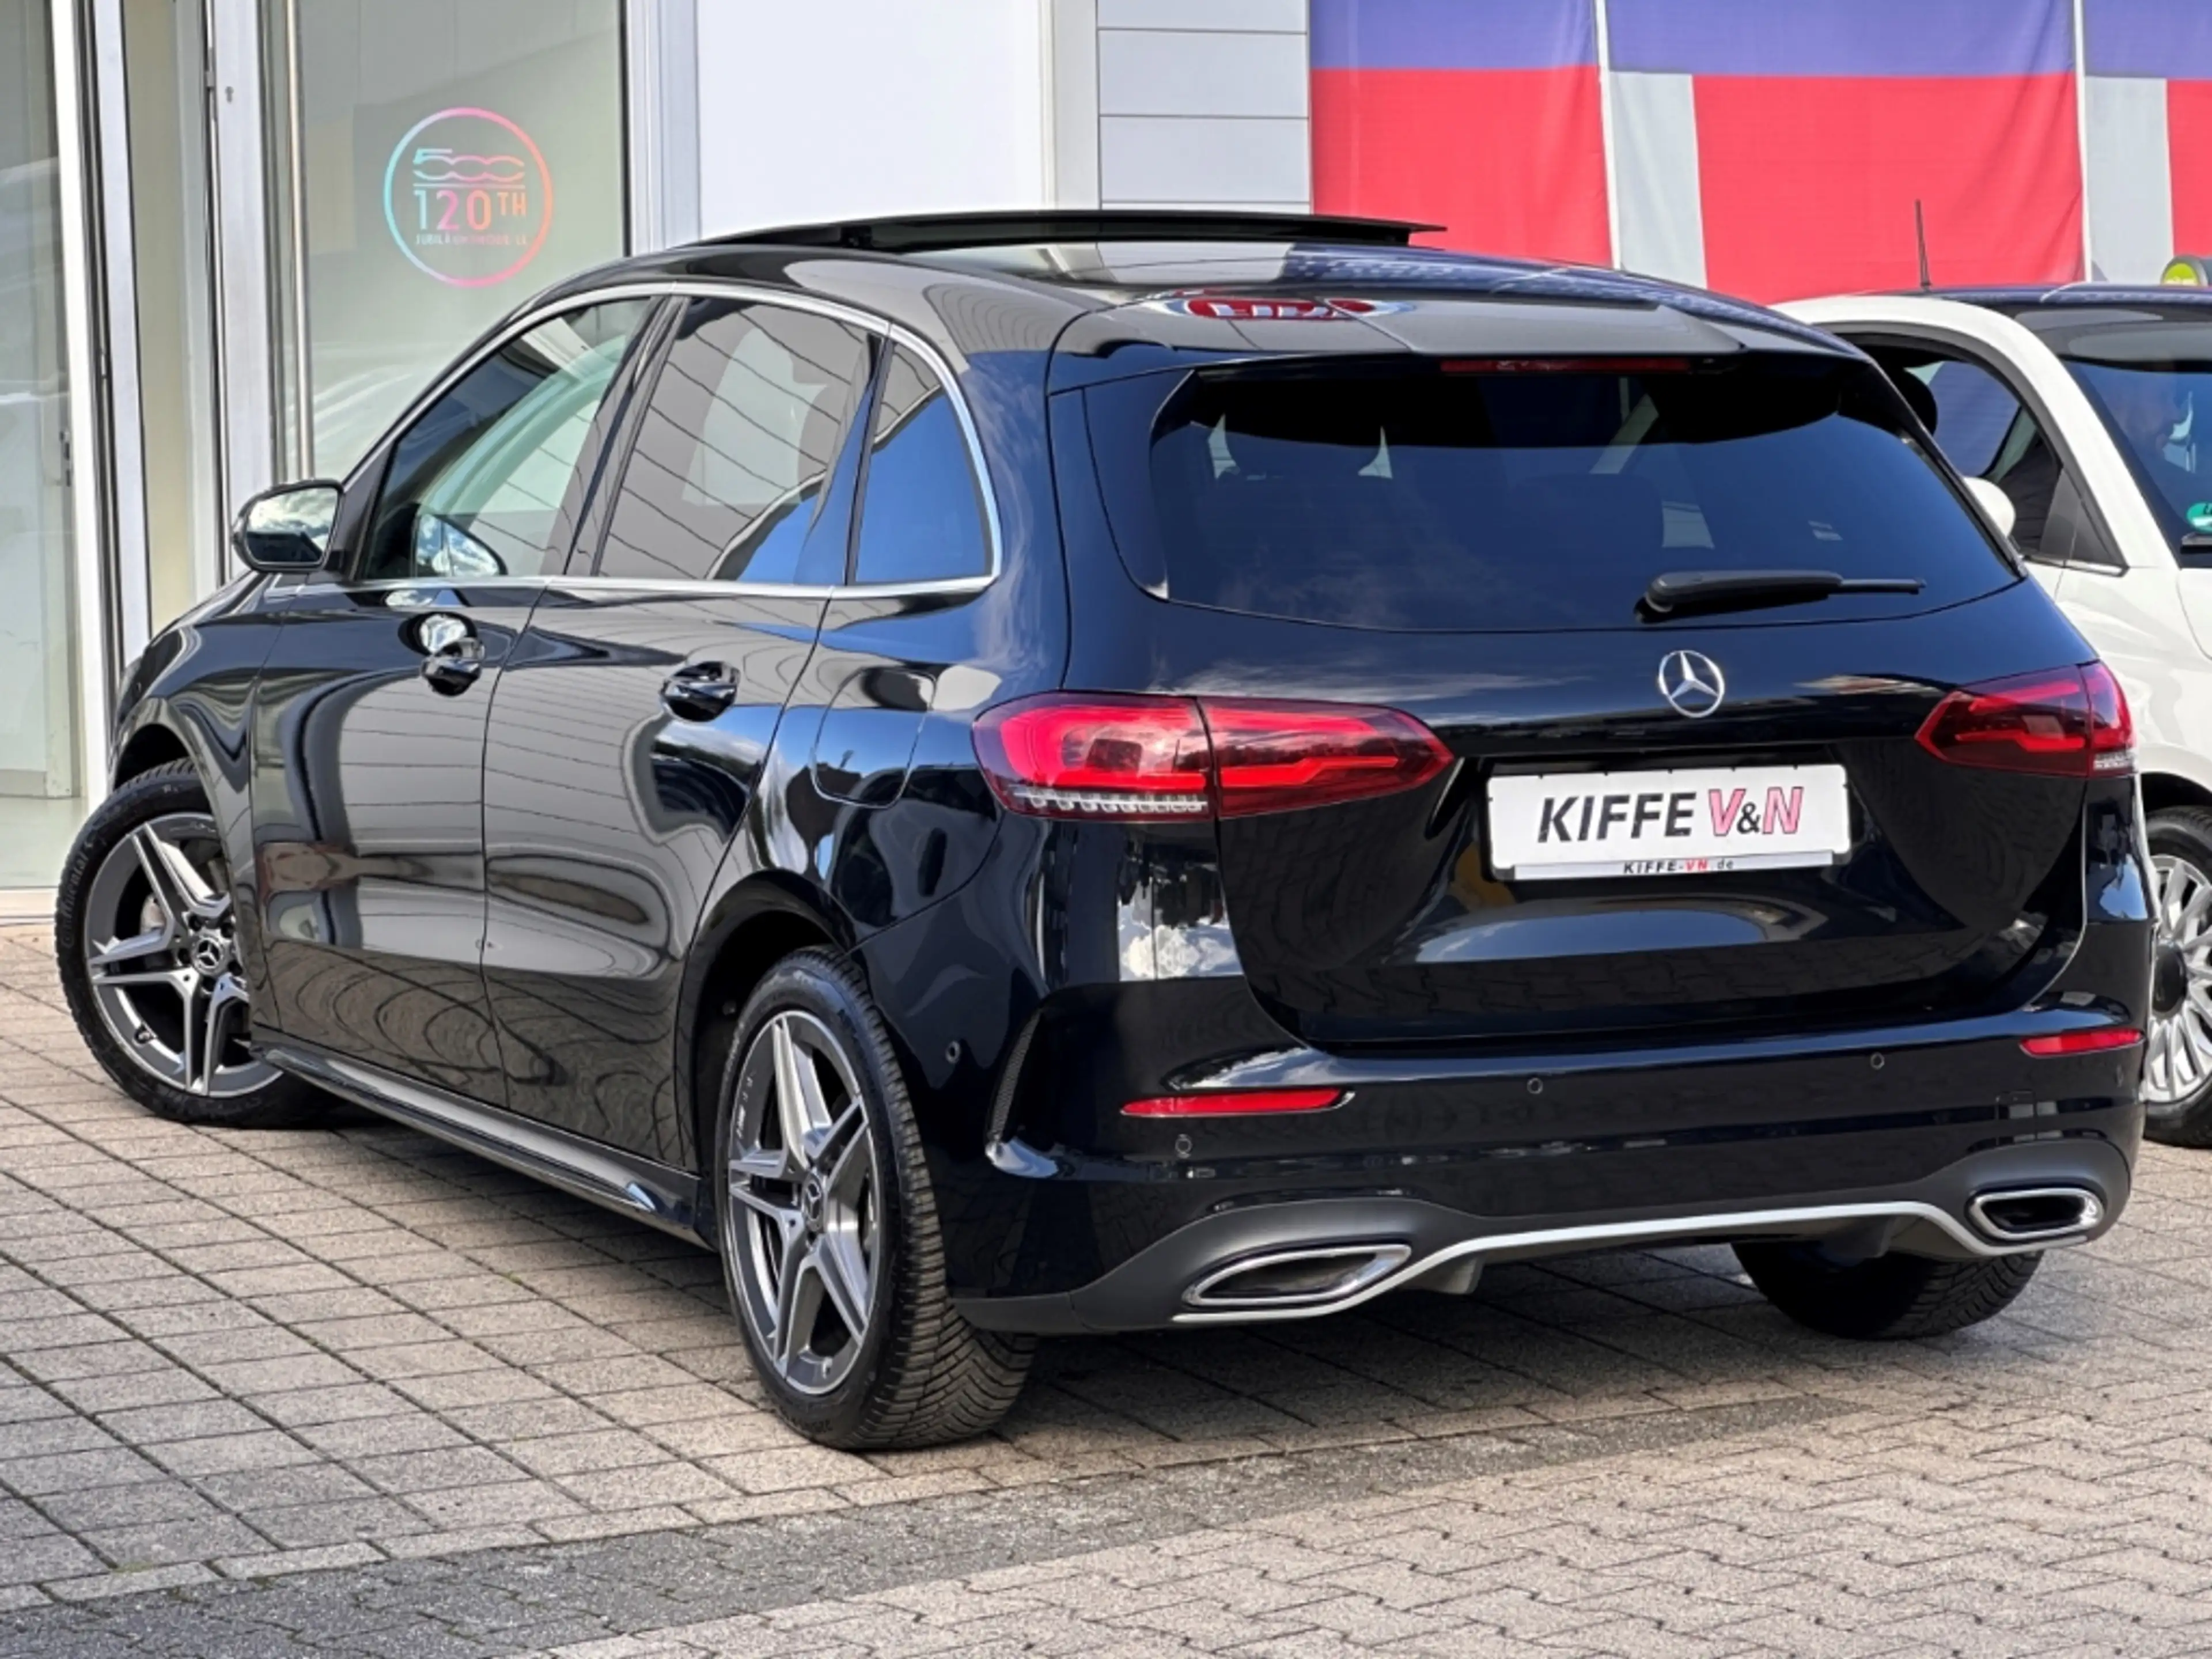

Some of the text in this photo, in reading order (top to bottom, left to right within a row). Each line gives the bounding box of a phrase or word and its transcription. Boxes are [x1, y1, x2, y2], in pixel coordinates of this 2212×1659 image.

[412, 148, 525, 182] 500
[1537, 786, 1804, 843] KIFFE V&N
